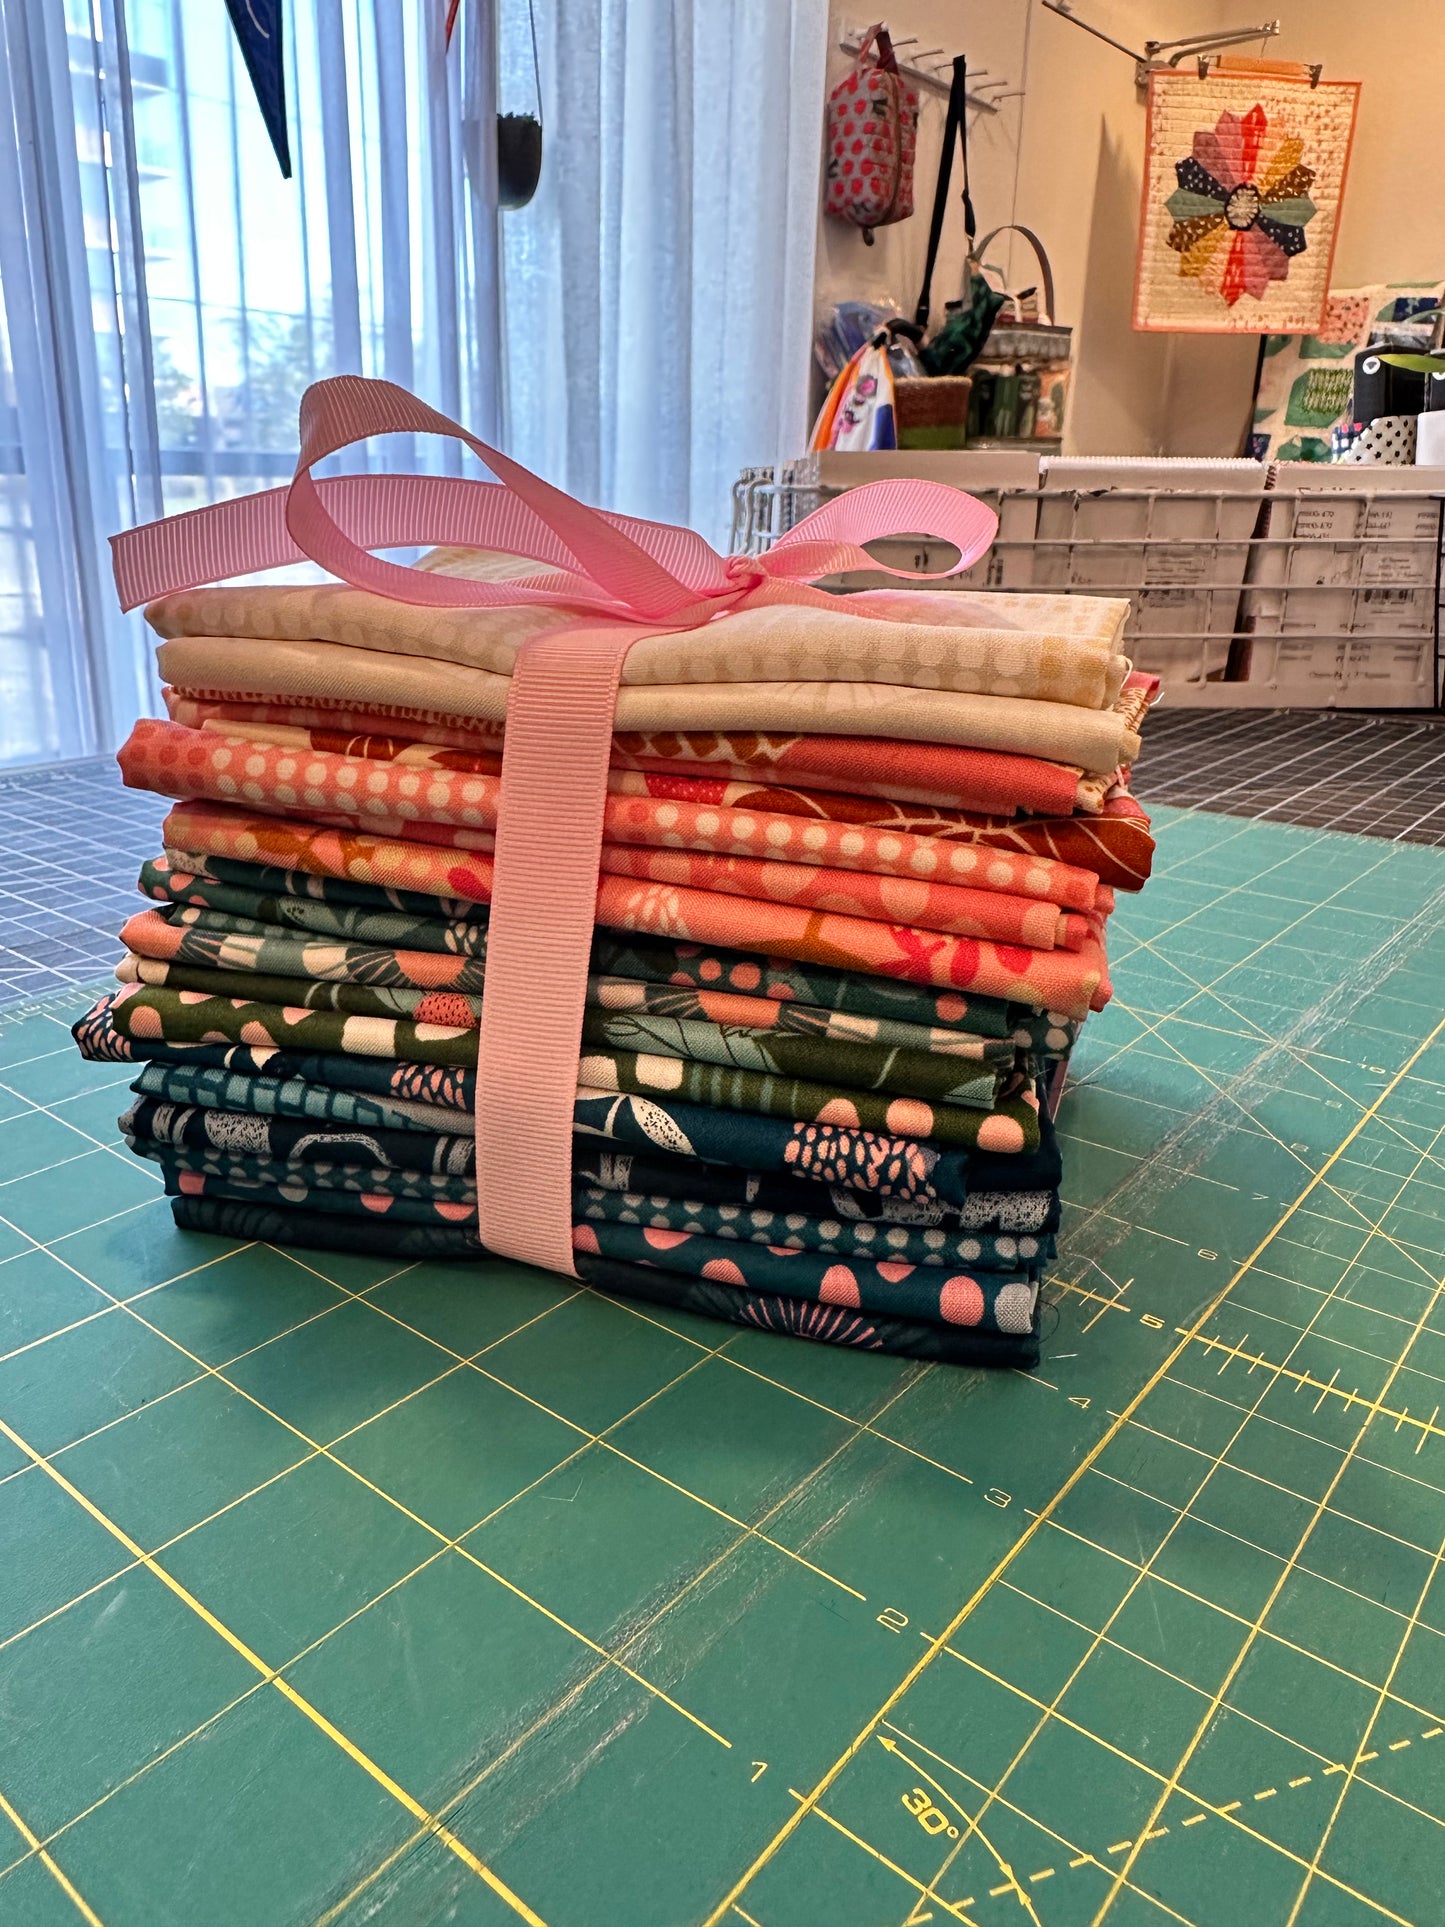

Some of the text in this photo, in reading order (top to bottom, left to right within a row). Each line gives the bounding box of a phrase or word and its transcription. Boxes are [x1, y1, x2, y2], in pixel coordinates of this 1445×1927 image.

[1197, 1248, 1218, 1260] 6
[1139, 1313, 1165, 1329] 5
[1067, 1396, 1092, 1409] 4
[983, 1487, 1012, 1508] 3
[876, 1607, 909, 1634] 2
[751, 1761, 768, 1783] 1
[901, 1787, 959, 1839] 30°
